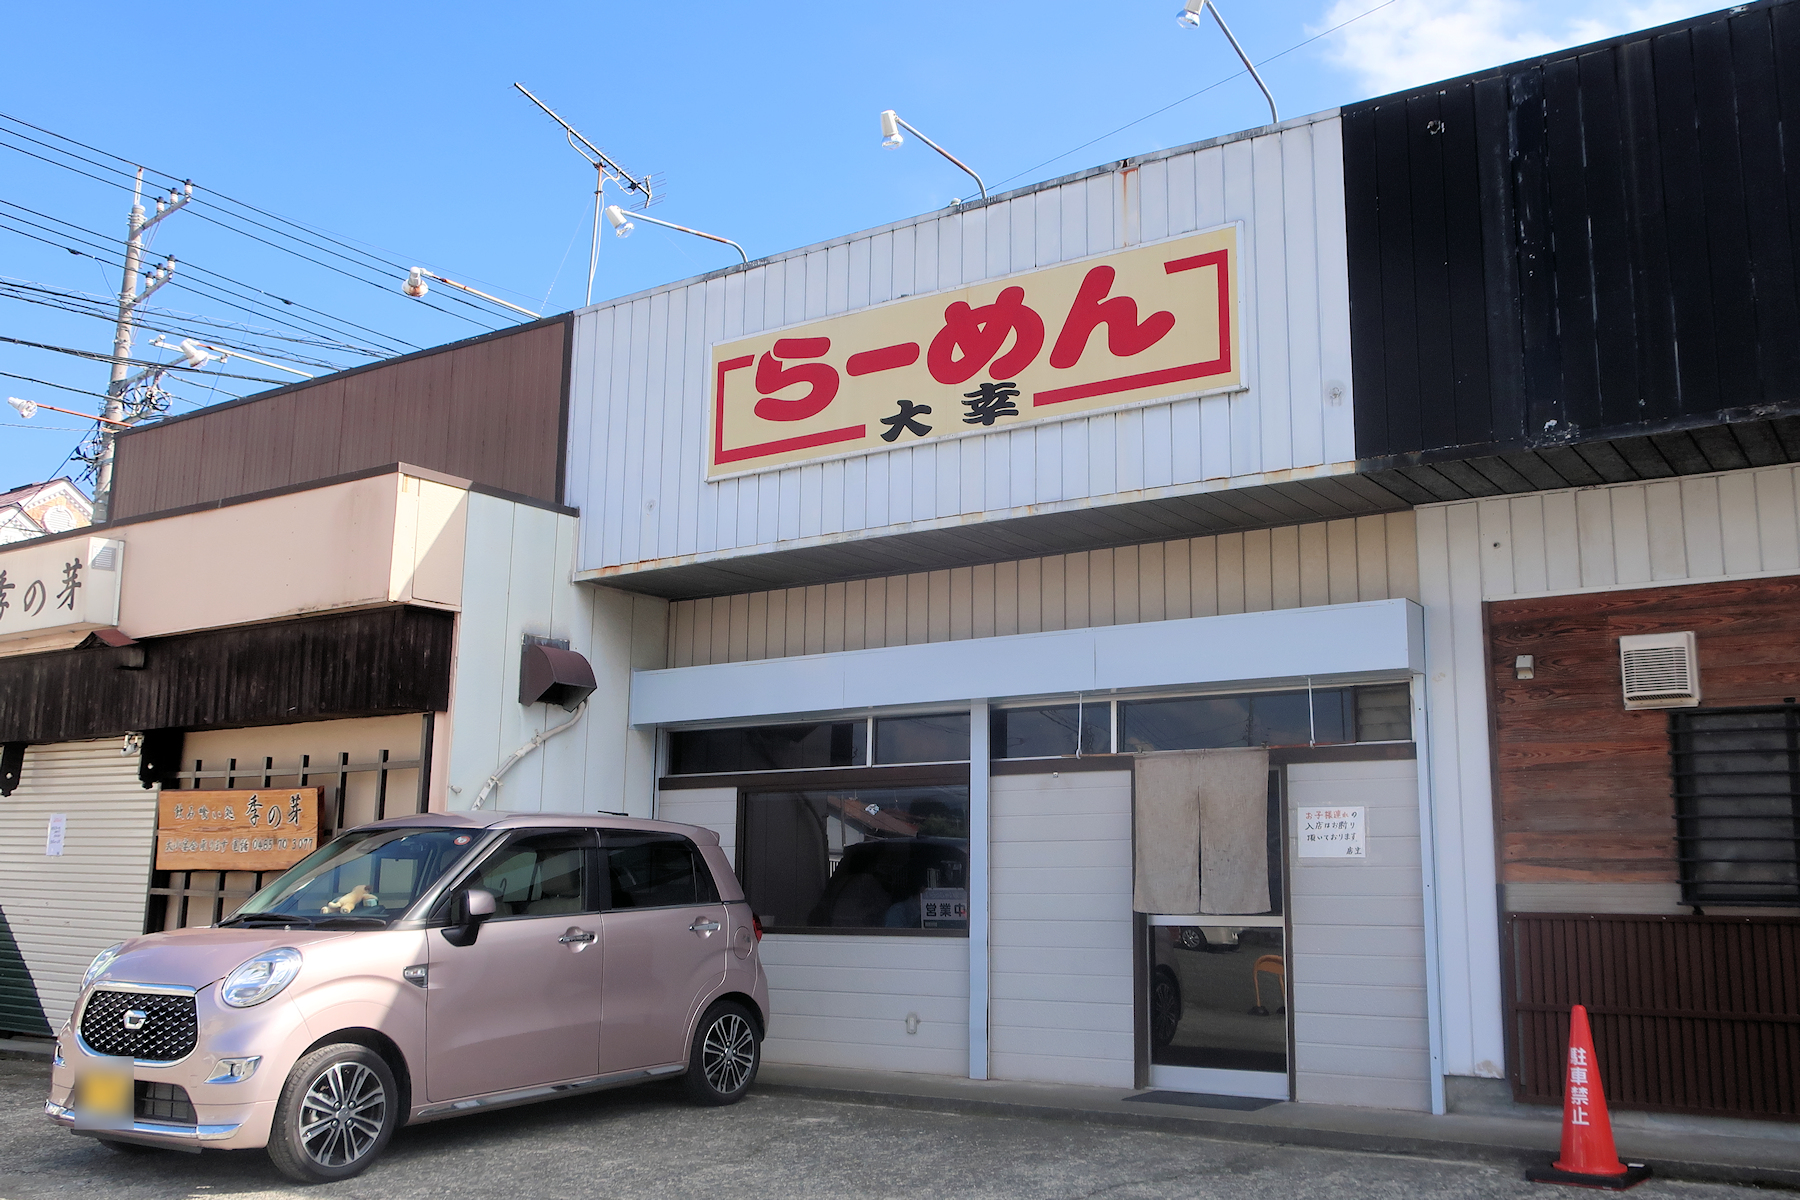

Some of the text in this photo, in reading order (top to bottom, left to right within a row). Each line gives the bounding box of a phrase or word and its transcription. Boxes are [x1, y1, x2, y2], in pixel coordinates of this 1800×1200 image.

[754, 265, 1176, 422] らーめん
[880, 382, 1020, 442] 大幸
[244, 793, 303, 829] 季の芽
[1304, 820, 1355, 831] 入店はお断り
[277, 838, 288, 851] 70
[291, 838, 314, 850] 3077
[925, 902, 966, 918] 営業中
[1570, 1046, 1591, 1126] 駐車禁止
